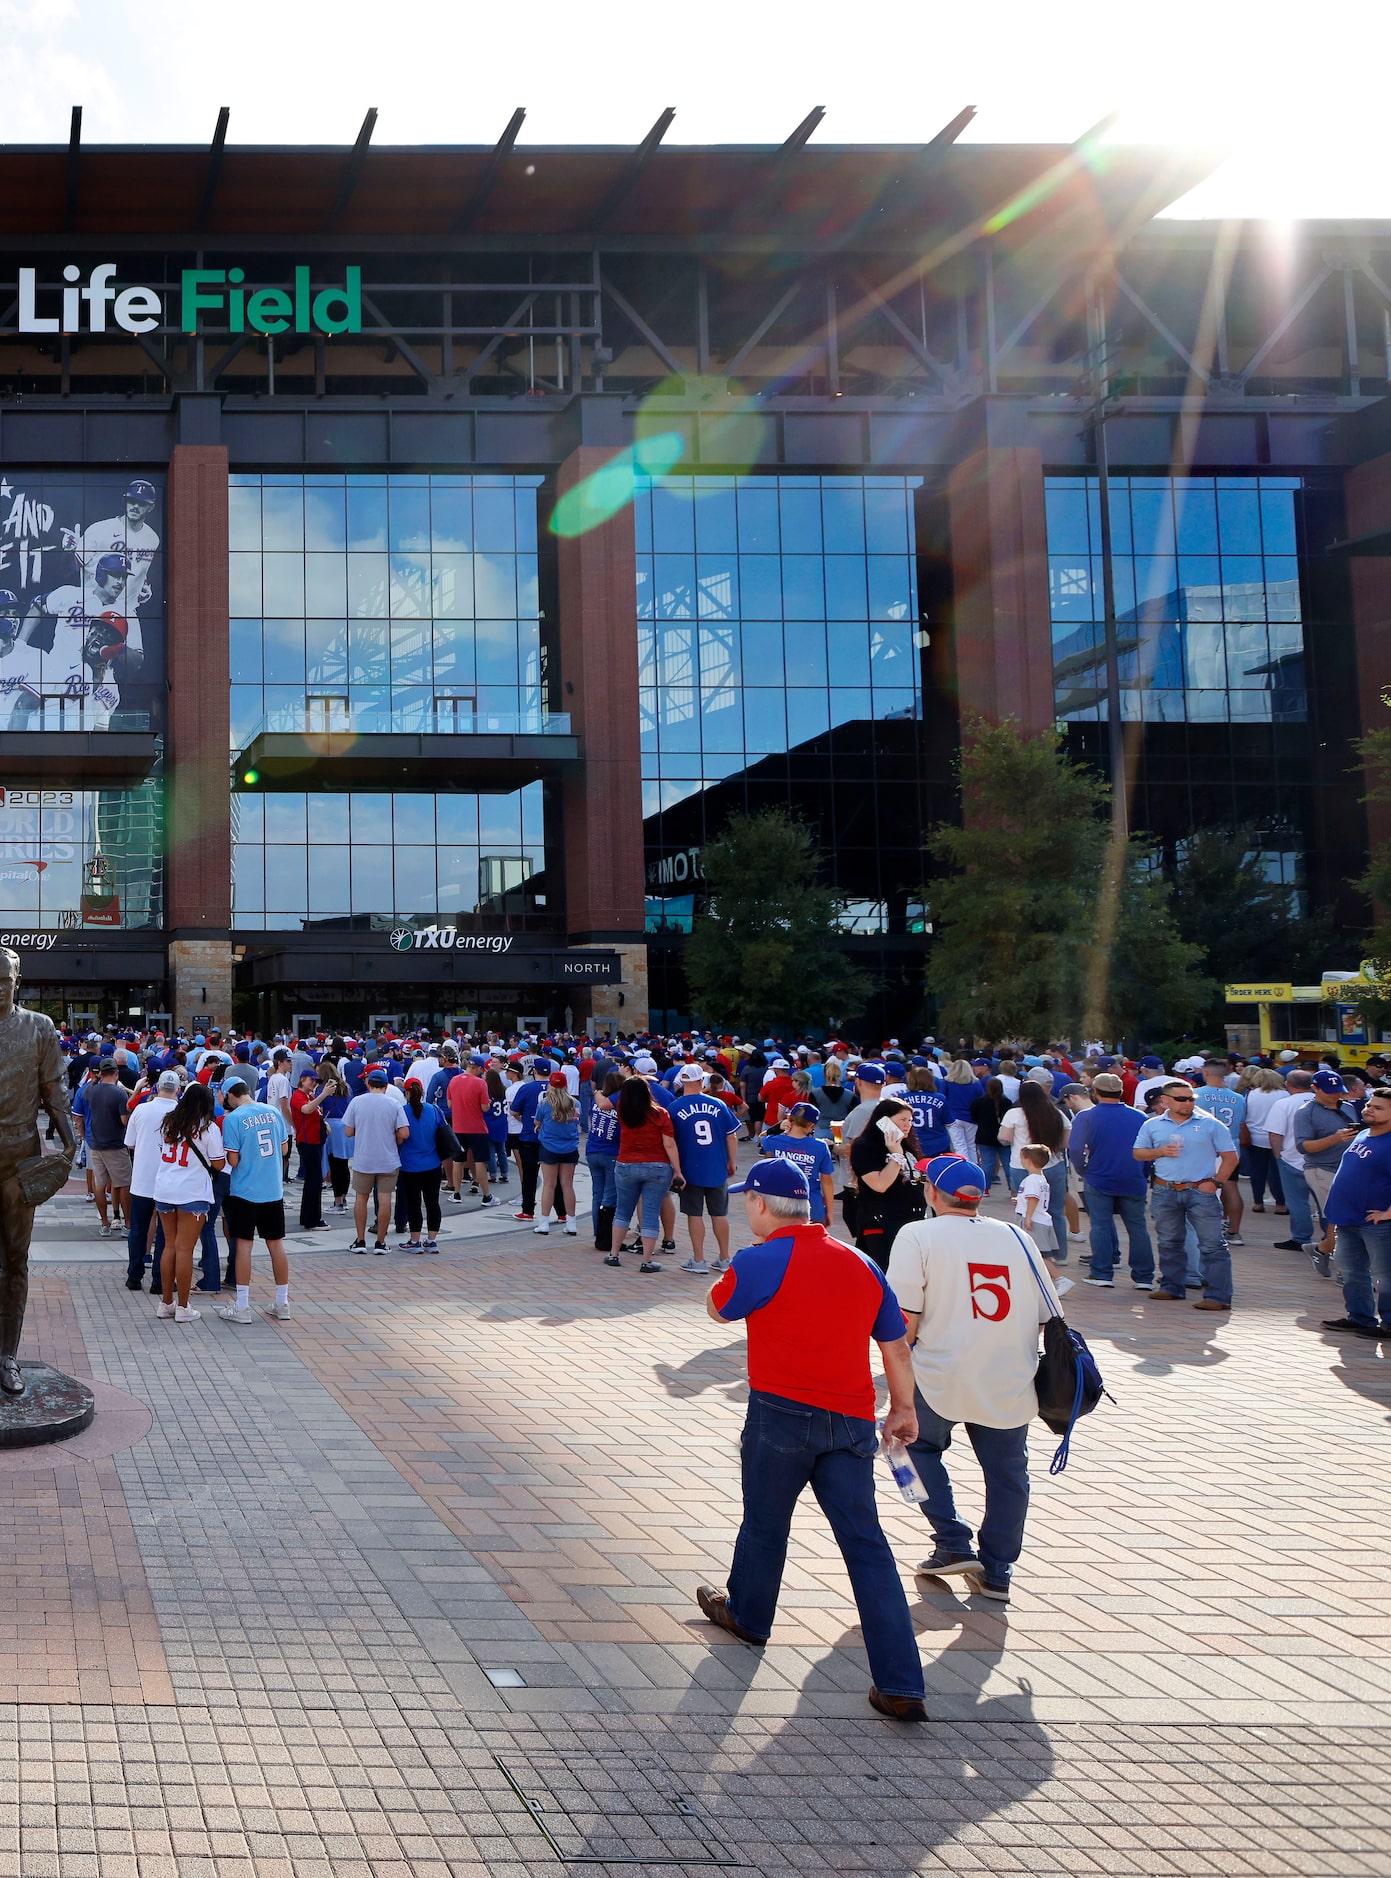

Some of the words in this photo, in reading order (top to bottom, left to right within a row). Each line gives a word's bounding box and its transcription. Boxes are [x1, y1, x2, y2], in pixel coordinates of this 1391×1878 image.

[18, 264, 161, 333] Life
[181, 265, 361, 334] Field
[2, 493, 55, 538] AND
[19, 545, 57, 589] IT
[10, 793, 73, 804] 2023
[0, 932, 57, 950] energy
[412, 930, 457, 948] TXU
[456, 934, 513, 952] energy
[564, 963, 610, 973] NORTH
[1204, 1094, 1237, 1104] GALLO
[243, 1113, 278, 1130] SEAGER
[677, 1104, 721, 1120] BLALOCK
[912, 1107, 933, 1128] 31
[1208, 1106, 1234, 1127] 13
[695, 1120, 713, 1145] 9
[162, 1138, 189, 1168] 31
[256, 1129, 273, 1158] 5
[1348, 1143, 1373, 1159] EXAS
[775, 1149, 815, 1164] RANGERS
[967, 1262, 1011, 1322] 5
